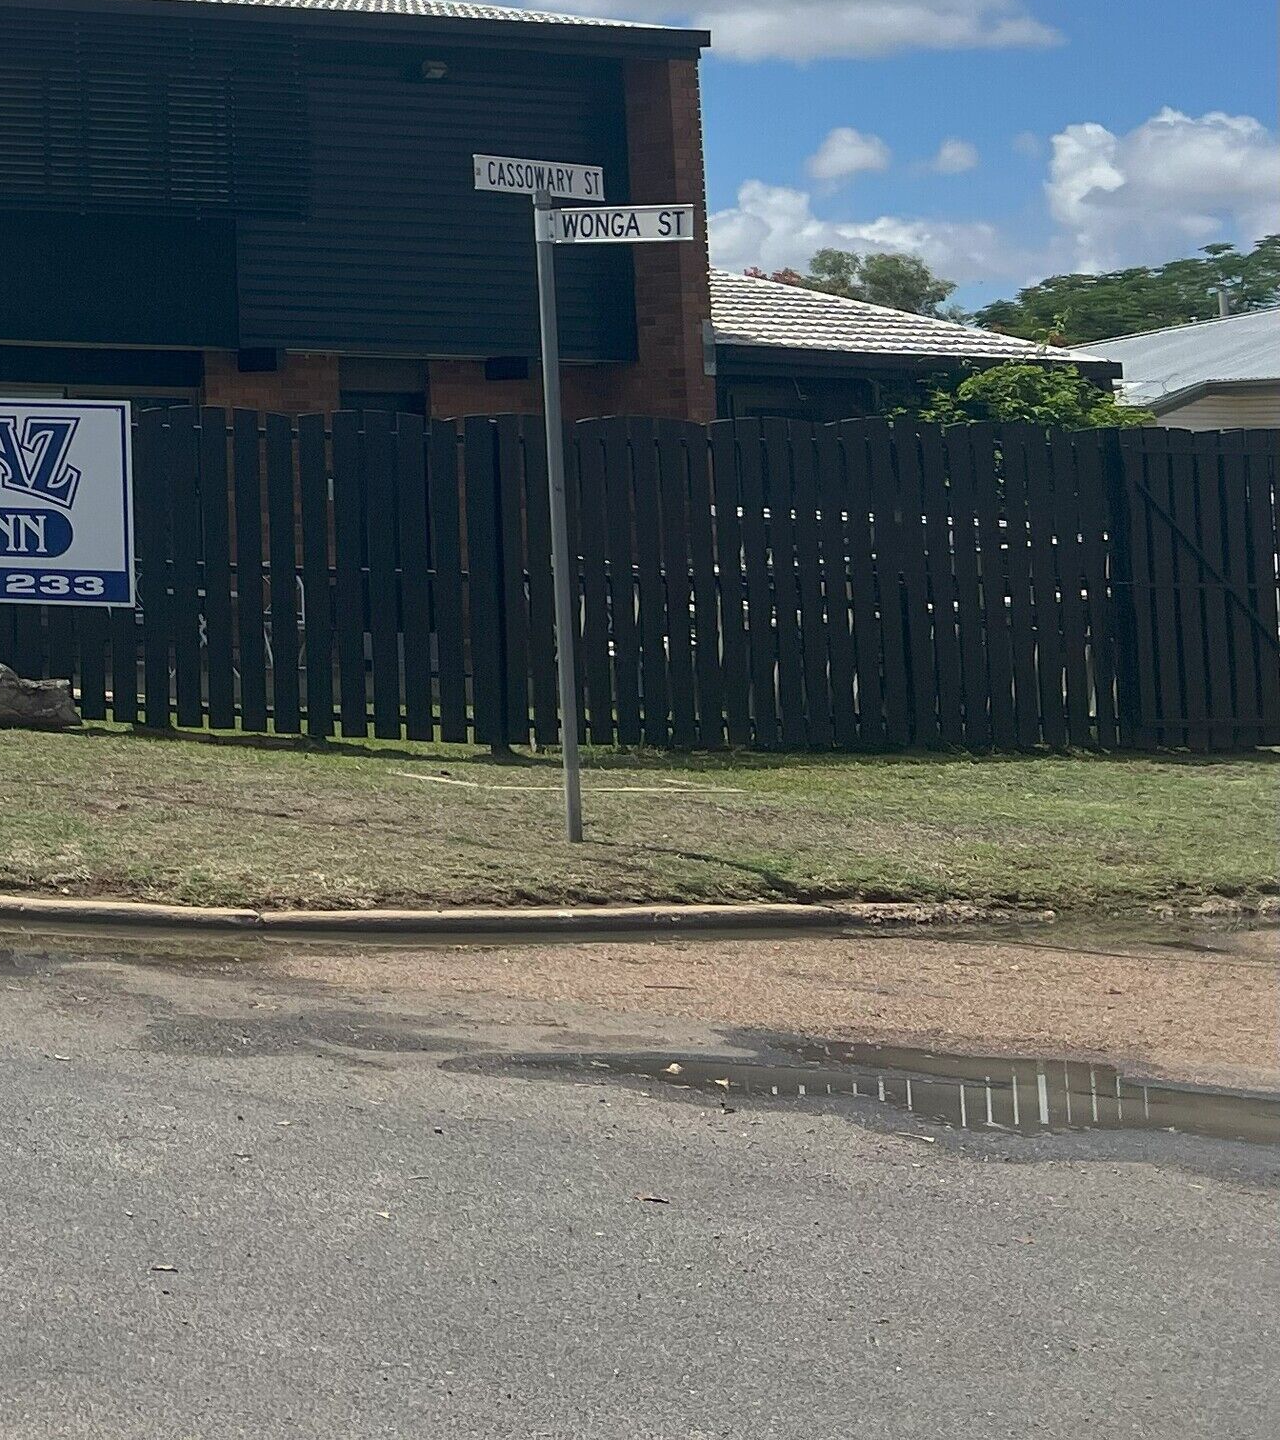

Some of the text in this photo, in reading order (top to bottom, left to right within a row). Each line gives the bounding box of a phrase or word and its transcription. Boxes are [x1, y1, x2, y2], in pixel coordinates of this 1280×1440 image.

[488, 161, 600, 196] CASSOWARY ST
[562, 211, 685, 238] WONGA ST
[5, 573, 105, 596] 233
